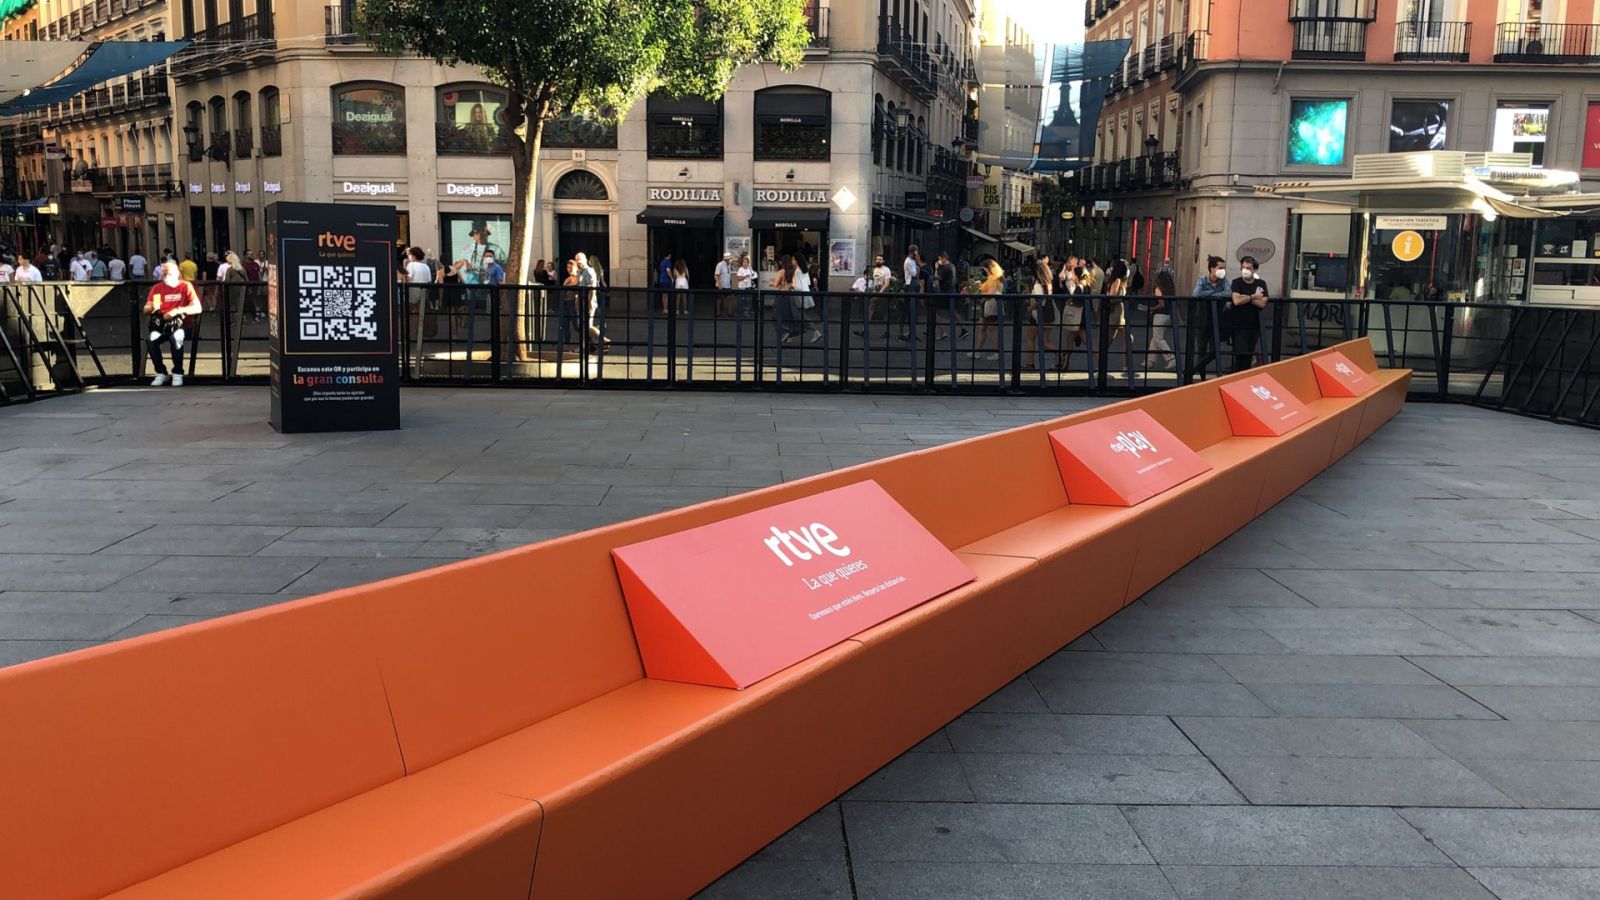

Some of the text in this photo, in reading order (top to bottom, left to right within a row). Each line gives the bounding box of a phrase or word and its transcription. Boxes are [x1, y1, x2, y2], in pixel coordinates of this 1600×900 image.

[650, 188, 721, 201] RODILLA
[756, 190, 827, 203] RODILLA
[983, 185, 997, 195] DIS
[983, 195, 999, 205] COS
[1021, 206, 1041, 214] DISCOS
[318, 231, 356, 251] rtve
[346, 366, 372, 374] participa
[293, 373, 384, 386] la gran consulta
[1116, 430, 1157, 458] play
[763, 522, 850, 567] rtve
[802, 560, 868, 590] La que quieres
